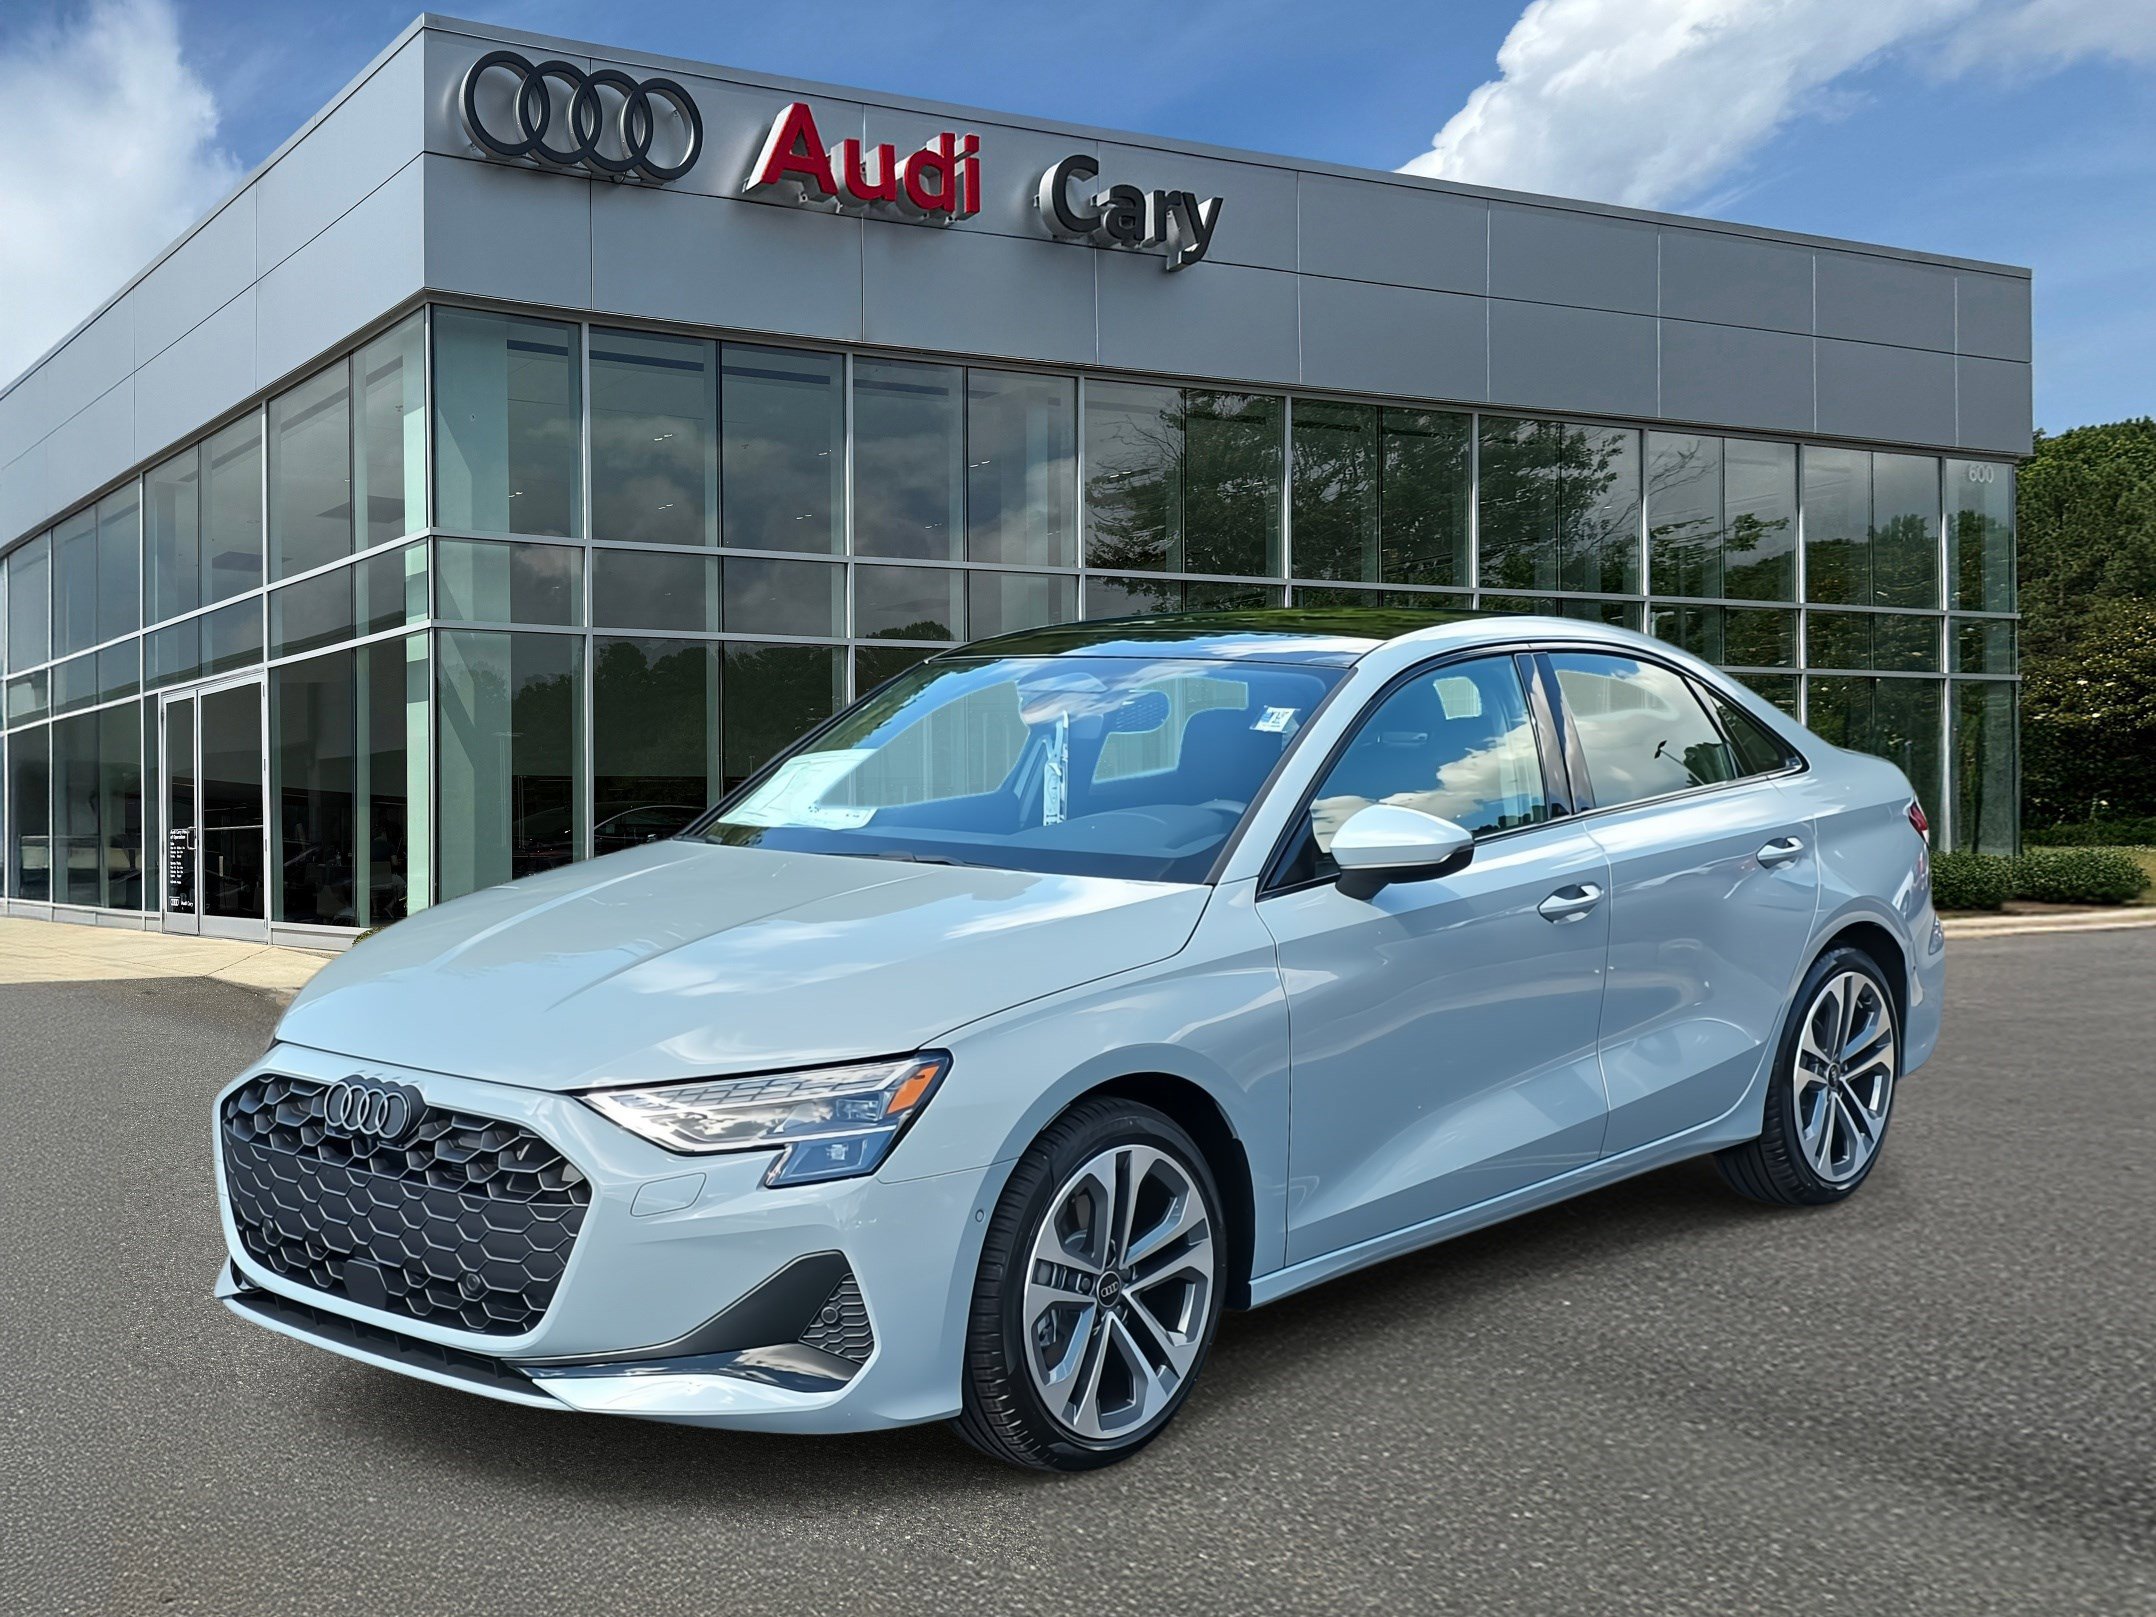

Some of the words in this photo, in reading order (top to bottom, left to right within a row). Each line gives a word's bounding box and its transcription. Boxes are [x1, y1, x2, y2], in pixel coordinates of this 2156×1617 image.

[752, 102, 981, 218] Audi
[1042, 154, 1224, 267] Cary
[1969, 464, 1994, 483] 600
